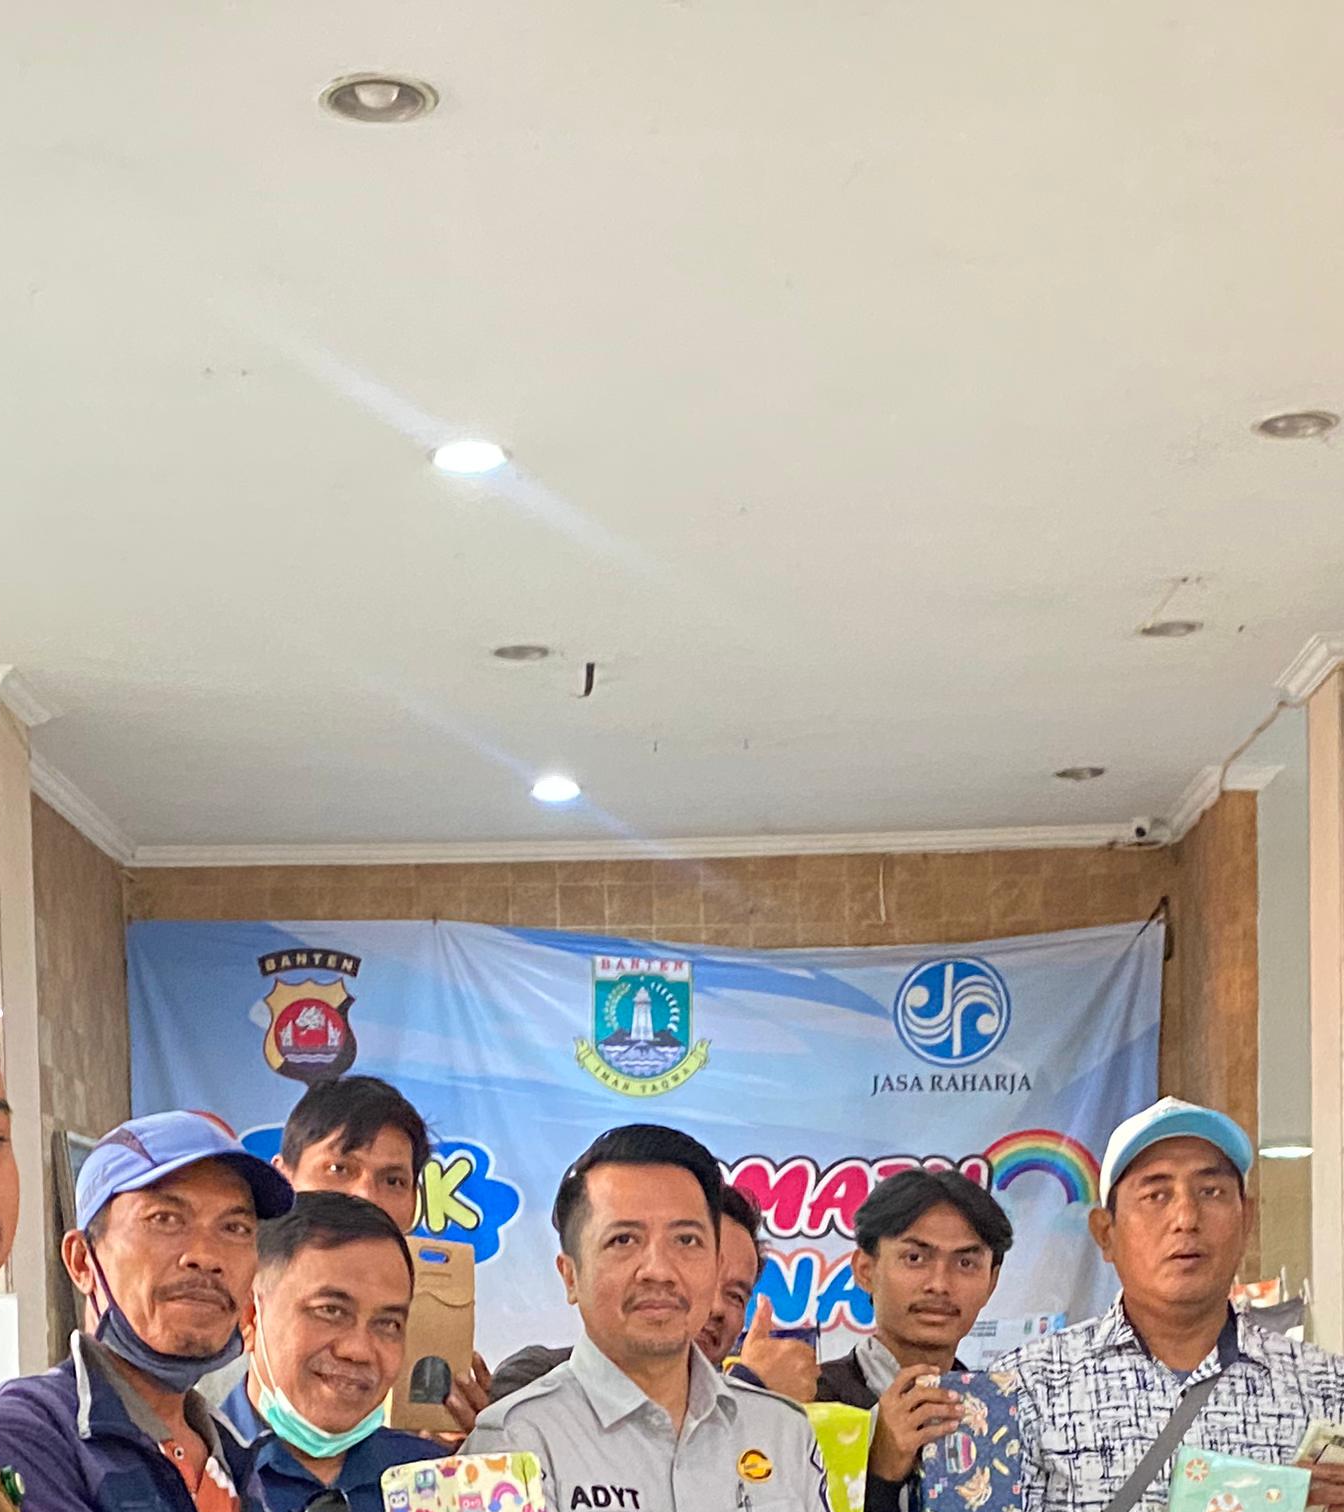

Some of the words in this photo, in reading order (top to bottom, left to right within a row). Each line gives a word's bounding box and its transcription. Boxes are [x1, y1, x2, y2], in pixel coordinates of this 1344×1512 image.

[264, 952, 355, 974] BANTEN
[600, 958, 684, 972] BANTEN
[594, 1065, 631, 1092] IMAN
[640, 1067, 691, 1094] TAQWA
[871, 1073, 923, 1096] JASA
[929, 1072, 1033, 1096] RAHARJA
[570, 1485, 641, 1511] ADYT
